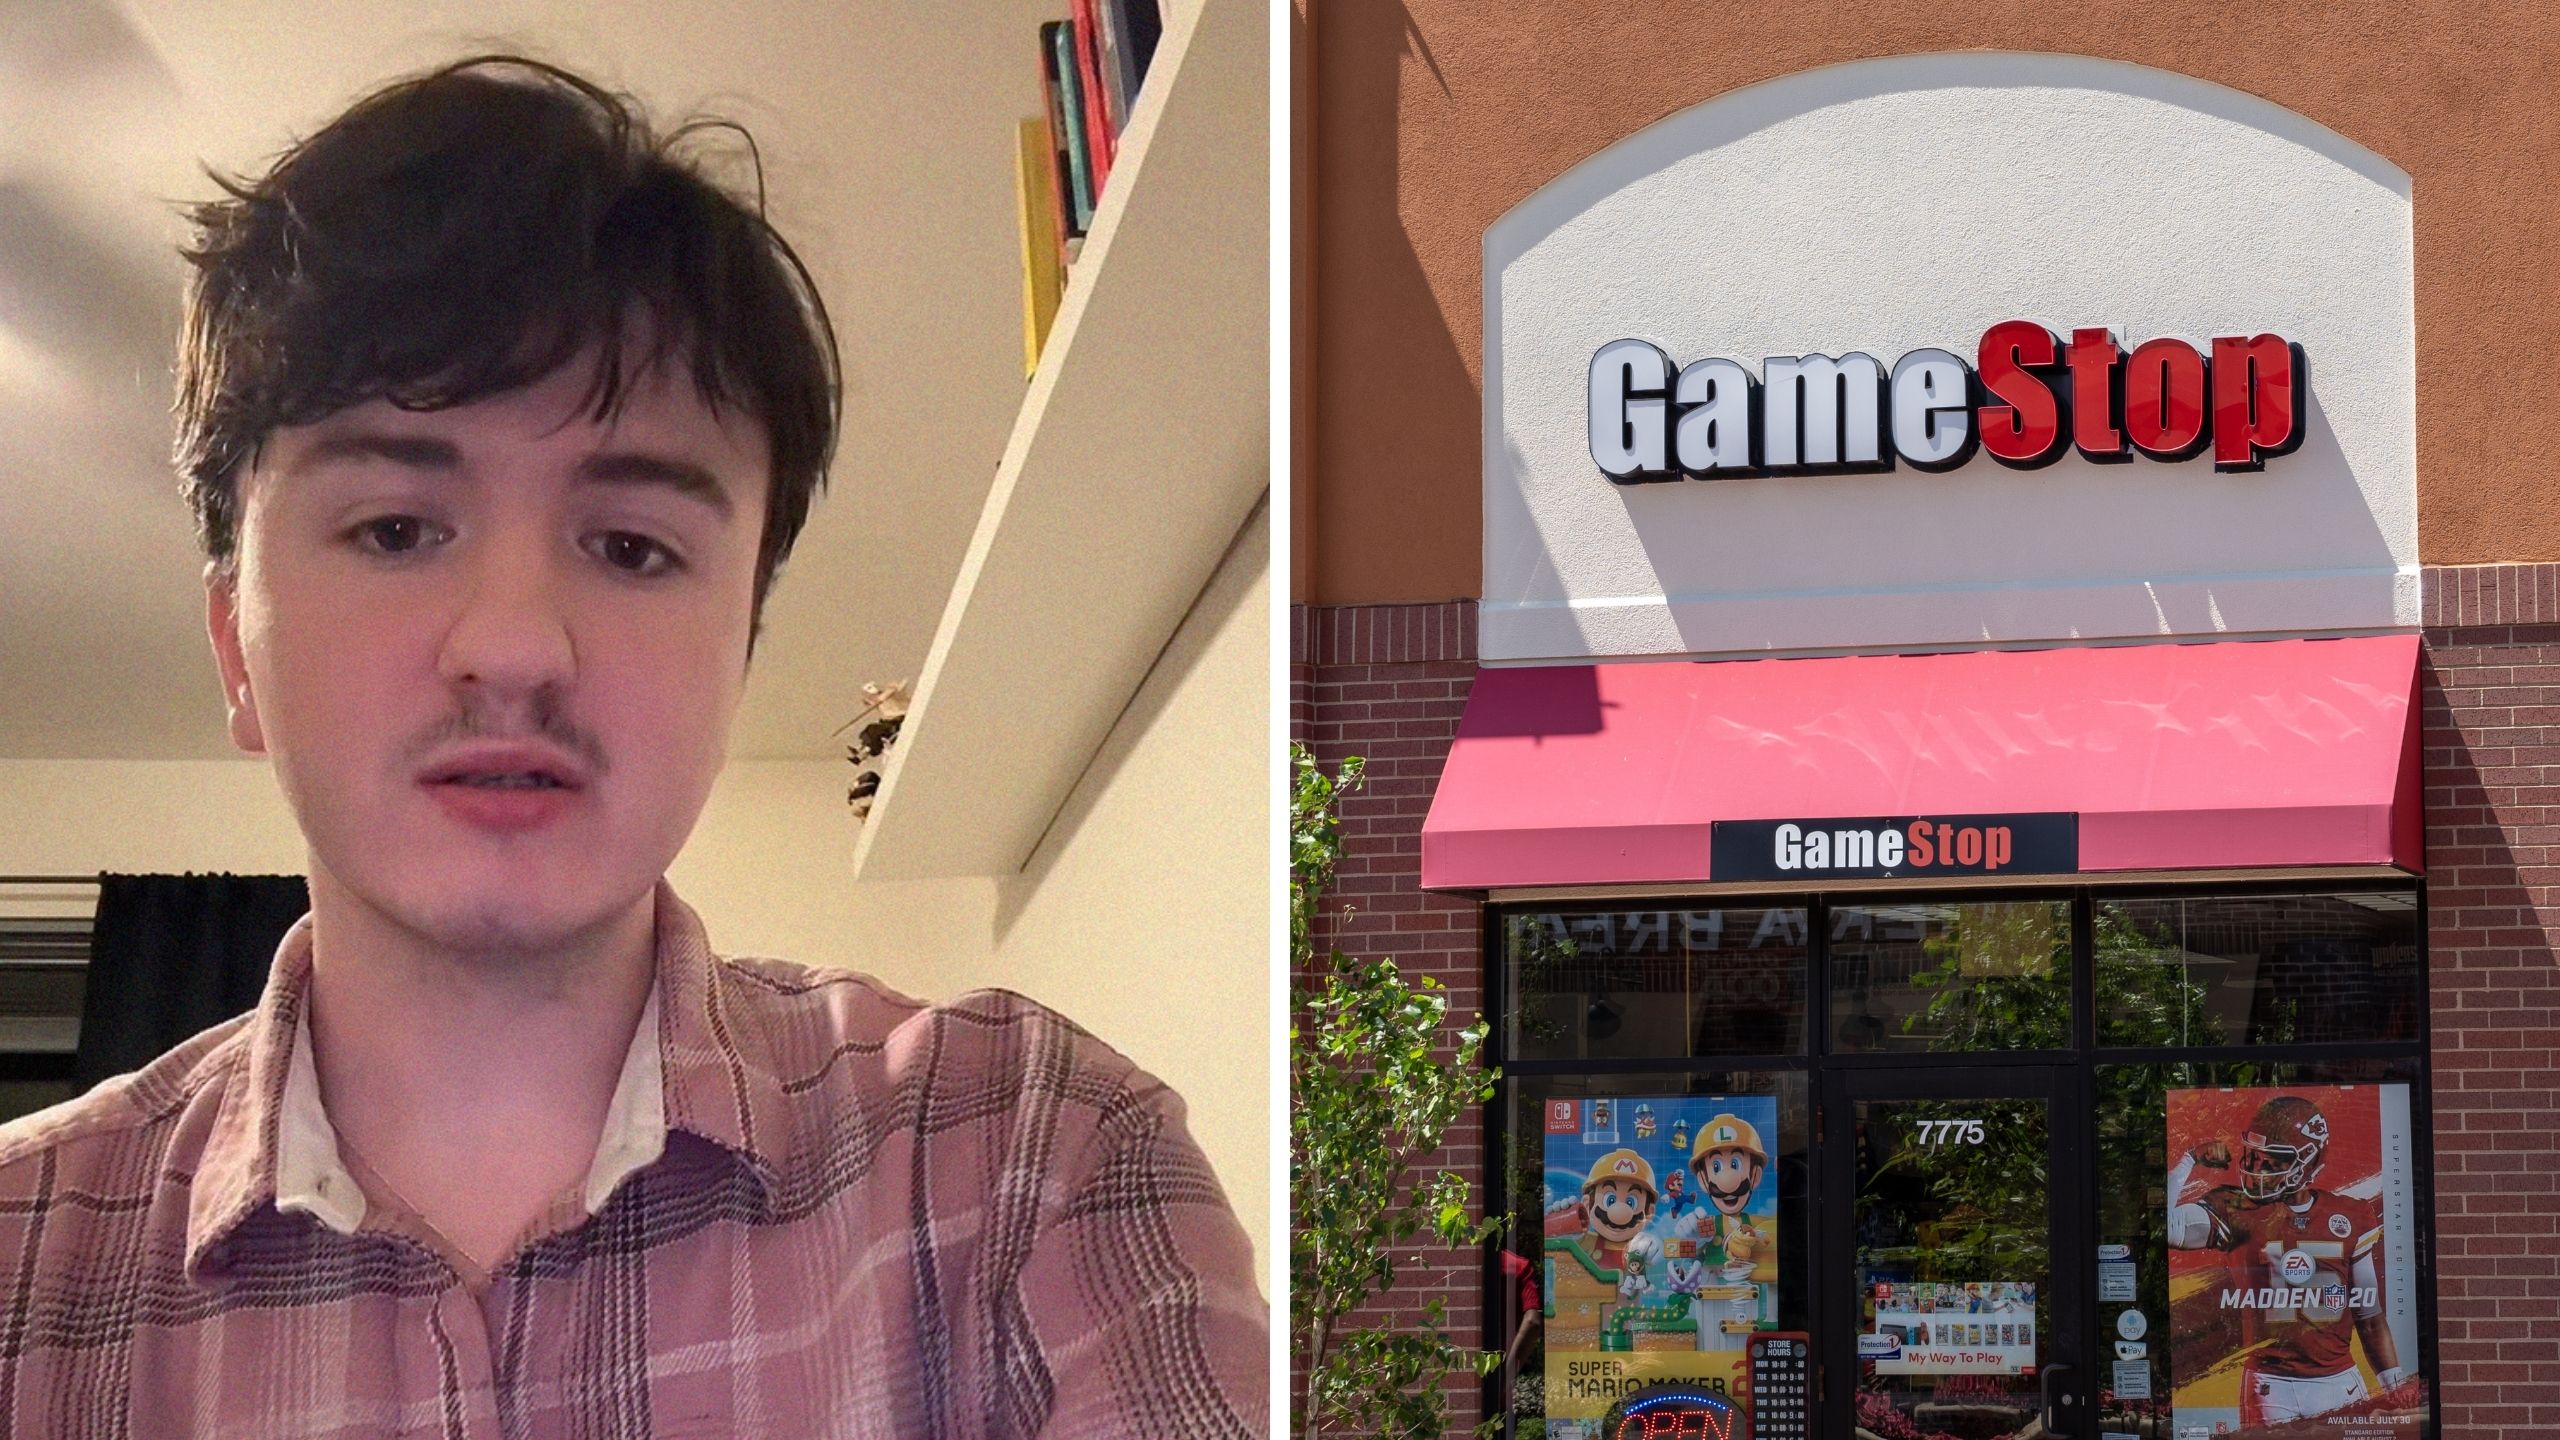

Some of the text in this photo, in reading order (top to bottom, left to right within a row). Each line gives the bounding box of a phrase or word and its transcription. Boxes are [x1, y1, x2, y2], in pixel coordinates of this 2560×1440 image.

[1589, 319, 2303, 482] GameStop
[1775, 820, 2011, 870] GameStop
[1917, 1120, 1984, 1145] 7775
[2392, 1134, 2404, 1316] SUPERSTAR EDITION
[2286, 1256, 2310, 1269] EA
[2220, 1287, 2377, 1309] MADDEN NFL 20
[1768, 1340, 1790, 1348] STORE
[1768, 1348, 1791, 1356] HOURS
[2128, 1345, 2142, 1355] Pay
[1908, 1352, 2002, 1365] My Way To Play
[1569, 1361, 1622, 1376] SUPER
[1568, 1378, 1642, 1398] MARIO
[1617, 1408, 1734, 1440] OPEN
[2327, 1416, 2411, 1425] AVAILABLE JULY 30
